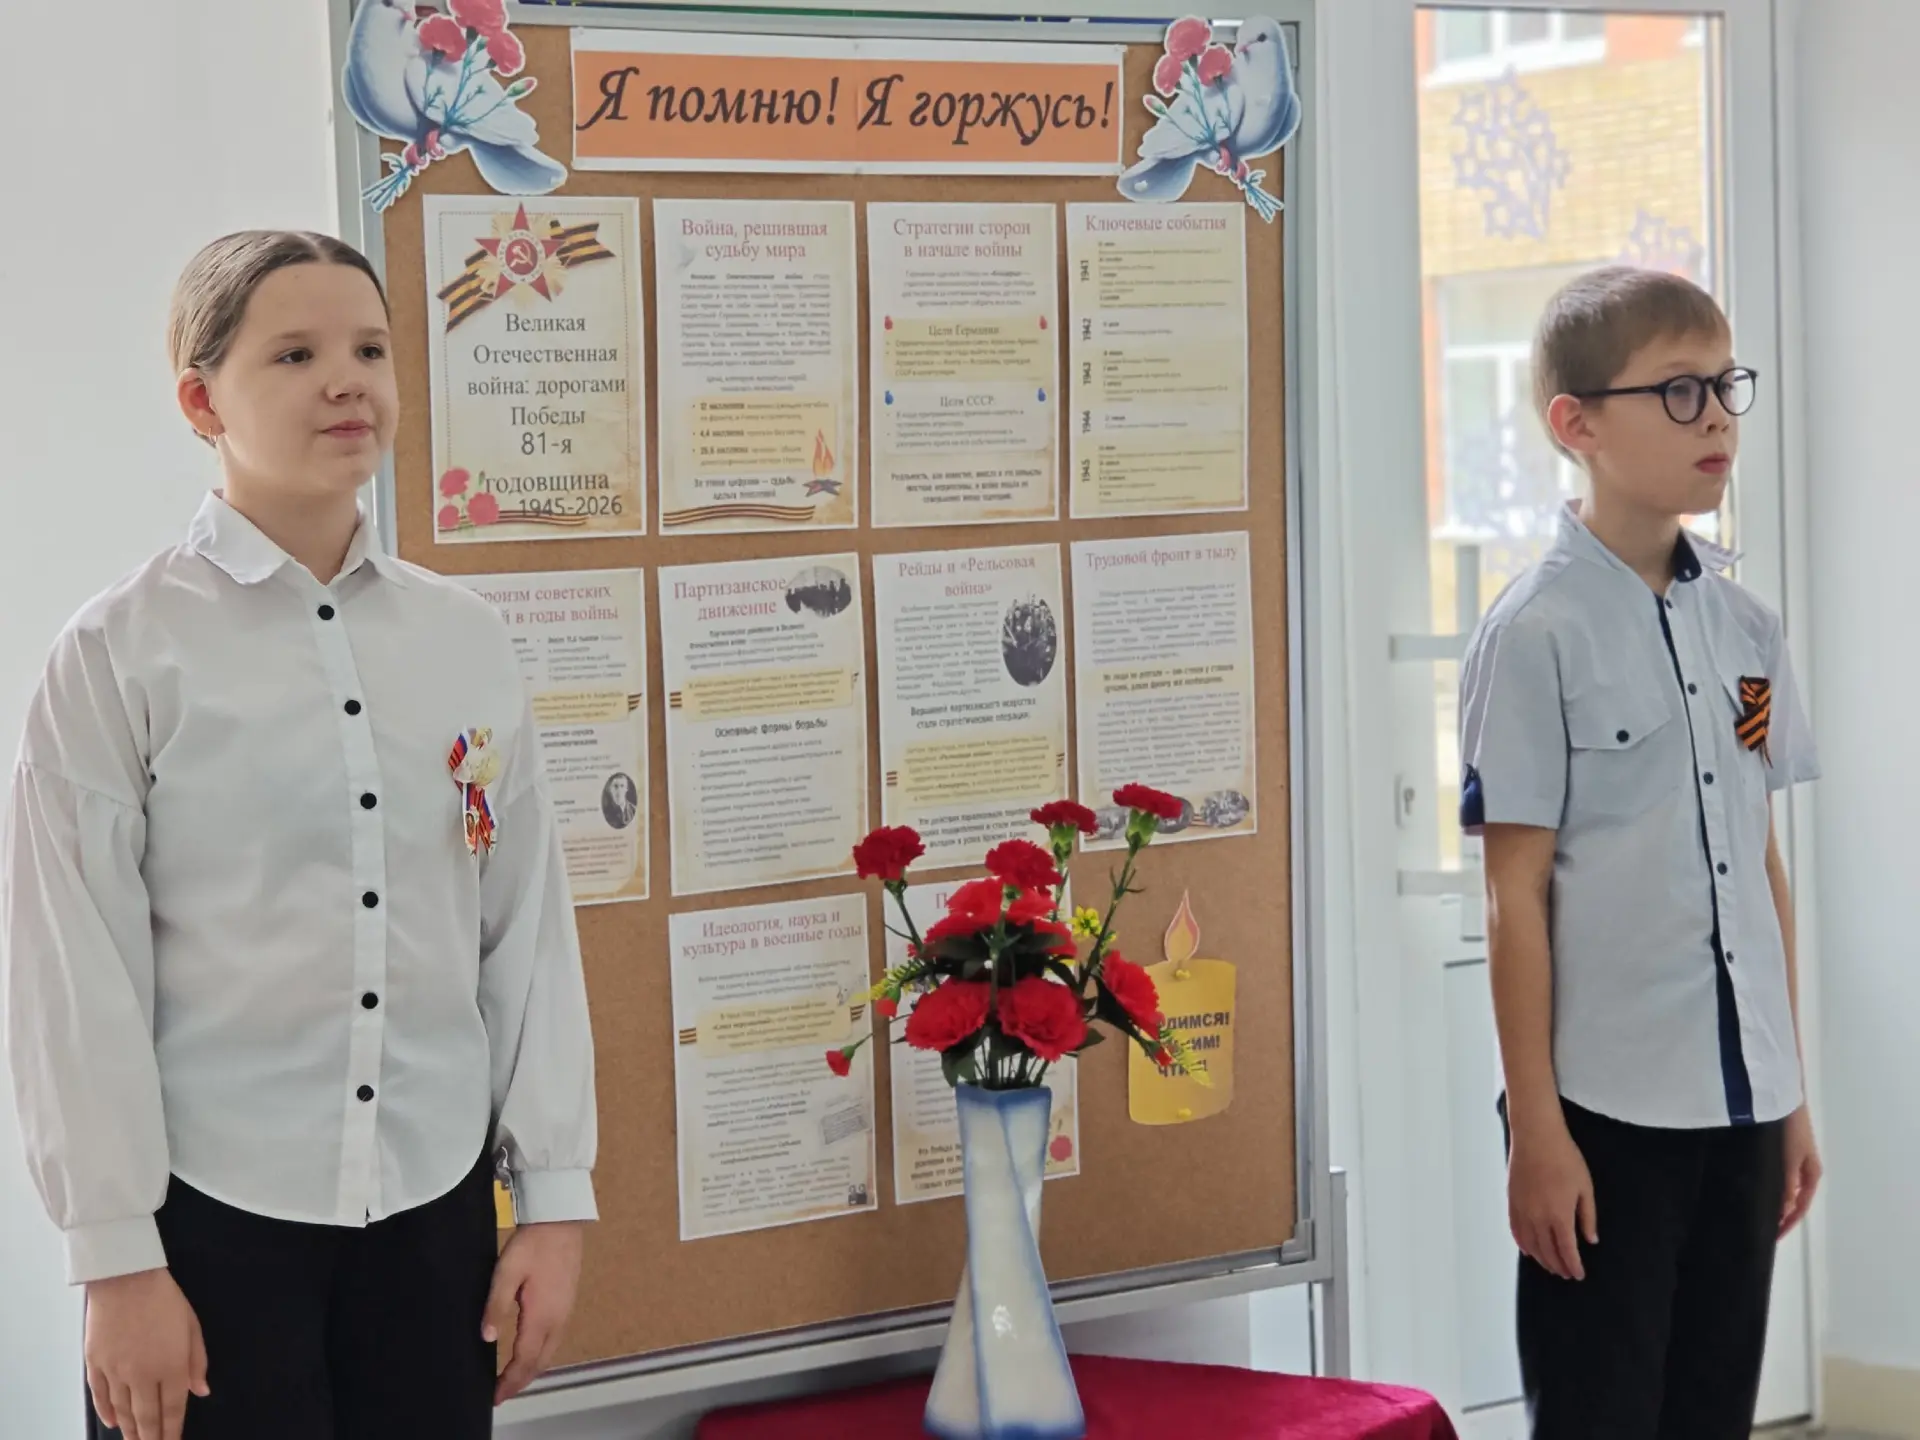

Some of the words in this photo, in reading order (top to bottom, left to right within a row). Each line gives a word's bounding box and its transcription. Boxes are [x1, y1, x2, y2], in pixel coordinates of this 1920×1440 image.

[576, 65, 640, 131] Я
[647, 77, 839, 127] помню!
[857, 74, 904, 131] Я
[908, 81, 1114, 146] горжусь!
[681, 218, 737, 238] Война,
[744, 222, 828, 239] решившая
[893, 218, 974, 239] Стратегии
[979, 223, 1031, 239] сторон
[1085, 214, 1163, 232] Ключевые
[1166, 214, 1227, 231] события
[706, 240, 760, 262] судьбу
[766, 246, 806, 261] мира
[904, 245, 912, 257] в
[918, 244, 970, 258] начале
[974, 241, 1023, 257] войны
[505, 312, 586, 332] Великая
[473, 344, 618, 364] Отечественная
[467, 377, 530, 396] война:
[535, 377, 626, 401] дорогами
[511, 406, 585, 427] Победы
[521, 432, 572, 455] 81-я
[485, 473, 610, 494] годовщина
[519, 496, 622, 517] 1945-2026
[899, 560, 942, 577] Рейды
[947, 563, 955, 573] и
[961, 555, 1036, 573] «Рельсовая
[1086, 549, 1147, 571] Трудовой
[1151, 548, 1191, 567] фронт
[1195, 550, 1202, 560] в
[1206, 547, 1238, 561] тылу
[535, 586, 612, 601] советских
[674, 577, 787, 602] Партизанское
[945, 581, 993, 597] война»
[516, 612, 524, 624] в
[529, 610, 565, 624] годы
[571, 605, 619, 621] войны
[698, 601, 777, 621] движение
[702, 918, 784, 939] Идеология,
[788, 911, 828, 931] наука
[832, 911, 841, 922] и
[682, 938, 747, 960] культура
[751, 937, 759, 949] в
[763, 929, 824, 947] военные
[828, 925, 862, 941] годы
[1167, 1011, 1230, 1030] ДИМСЯ!
